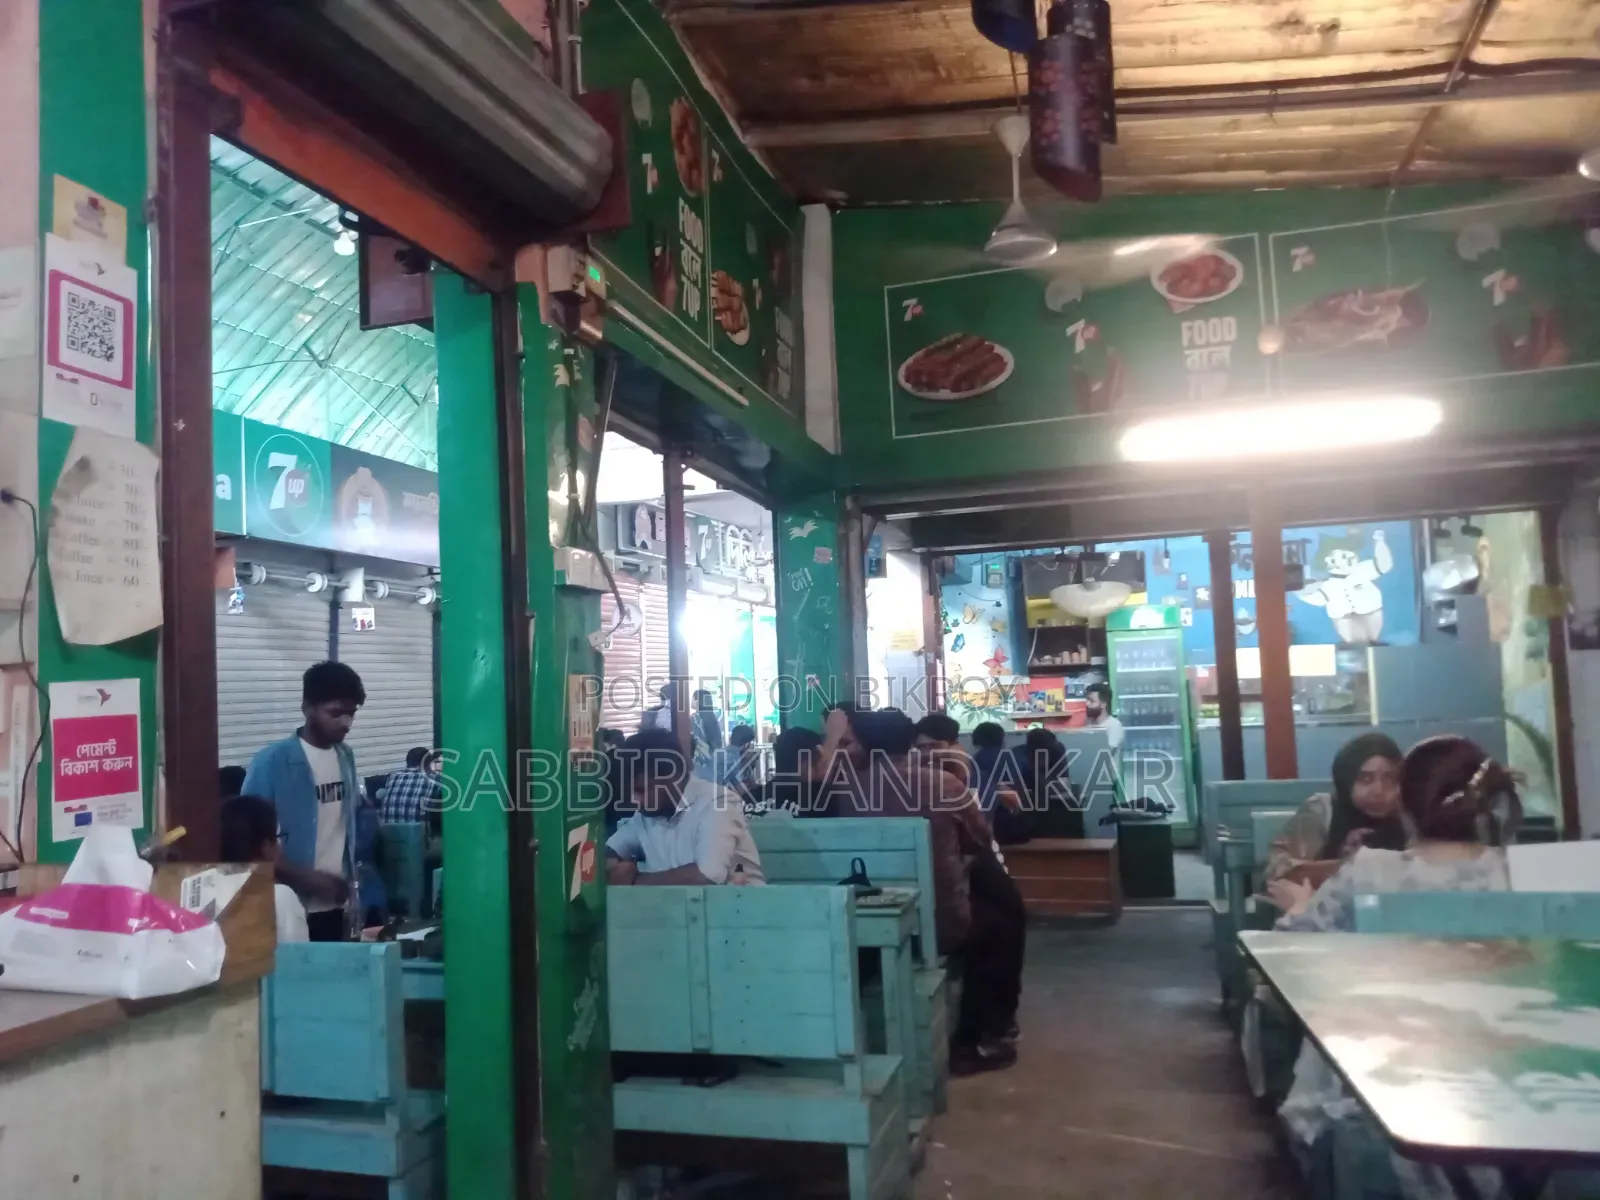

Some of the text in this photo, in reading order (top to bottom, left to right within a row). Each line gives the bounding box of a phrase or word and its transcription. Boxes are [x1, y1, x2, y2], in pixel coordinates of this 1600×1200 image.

[679, 196, 704, 254] FOOD
[1181, 316, 1237, 347] FOOD
[76, 738, 117, 758] পেমেন্ট
[60, 756, 133, 777] বিকাশ করুন
